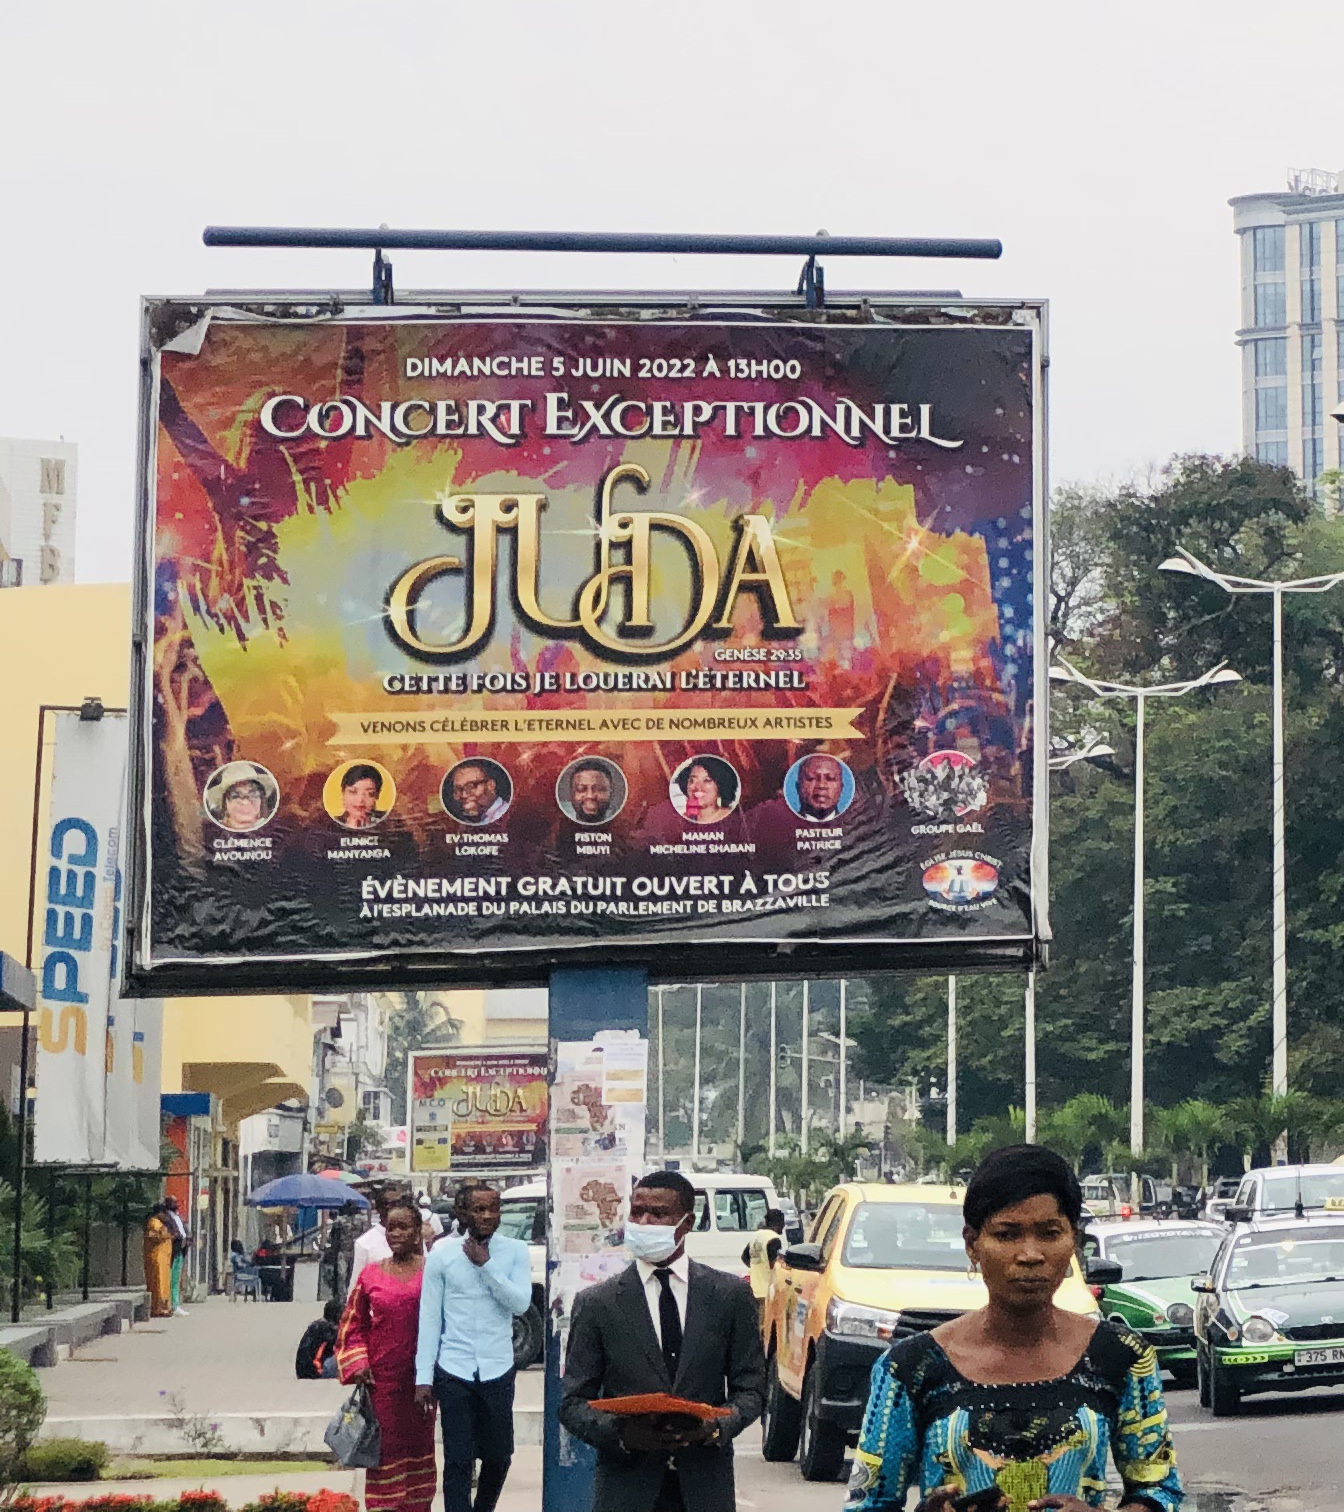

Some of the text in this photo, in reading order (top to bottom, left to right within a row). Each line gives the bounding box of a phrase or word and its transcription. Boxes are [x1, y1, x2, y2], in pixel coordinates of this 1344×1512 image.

[405, 353, 802, 380] DIMANCHE 5 JUIN 2022 À 13H00
[260, 392, 965, 448] CONCERT EXCEPTIONNEL
[388, 463, 801, 654] JUDA
[770, 647, 802, 661] 29:35
[382, 667, 806, 694] CETTE FOIS JE LOUERAI L'ÉTERNEL
[360, 716, 833, 734] VENONS CÉLÉBRER L'ETERNEL AVEC DE NOMBREUX ARTISTES
[682, 831, 724, 842] MAMAN
[795, 827, 844, 839] PASTEUR
[910, 823, 954, 835] GROUPE
[213, 837, 272, 849] CLÉMENCE
[576, 845, 611, 855] MBUYI
[650, 842, 756, 855] MICHELINE SHABANI
[797, 839, 842, 851] PATRICE
[102, 826, 119, 883] Telecom
[361, 869, 830, 901] ÉVÈNEMENT GRATUIT OUVERT À TOUS
[482, 901, 503, 916] DU
[509, 900, 567, 915] PALAIS
[570, 900, 593, 915] DU
[597, 900, 693, 915] PARLEMENT
[697, 899, 717, 914] DE
[723, 893, 830, 913] BRAZZAVILLE
[40, 816, 99, 1055] SPEED
[451, 1081, 527, 1118] JUDA
[1305, 1350, 1327, 1363] 375
